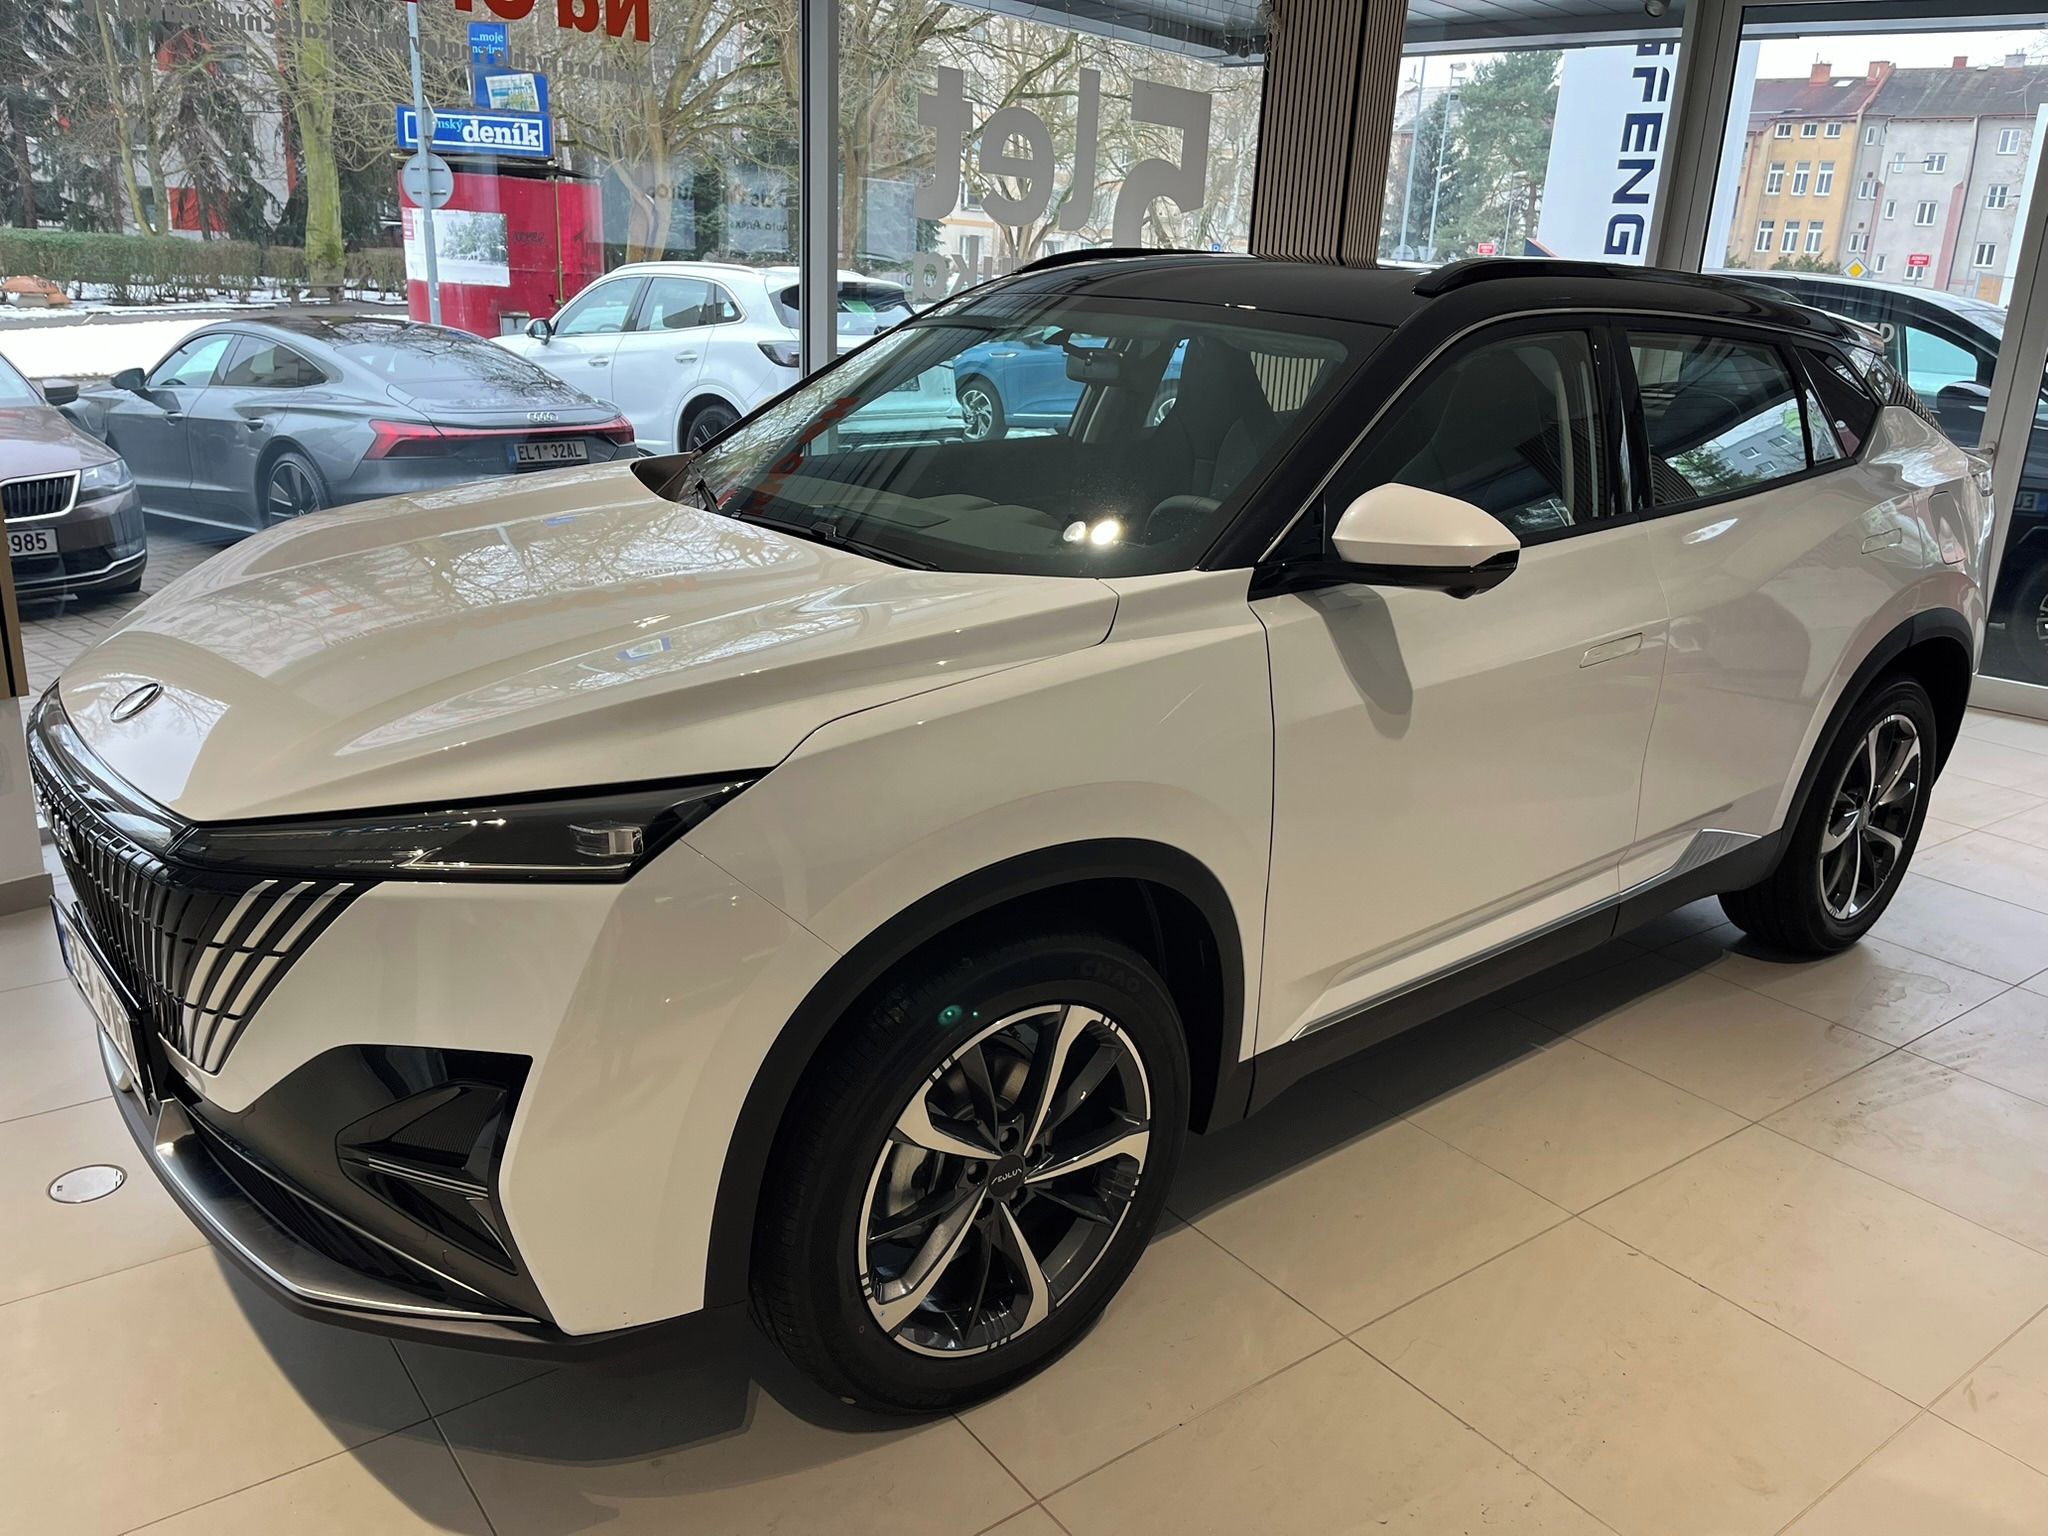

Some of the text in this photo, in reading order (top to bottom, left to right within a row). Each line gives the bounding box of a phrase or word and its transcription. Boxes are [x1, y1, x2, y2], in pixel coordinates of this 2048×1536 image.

[437, 118, 540, 147] nský deník
[517, 445, 542, 461] EL1
[550, 441, 582, 459] 32AL
[10, 532, 47, 553] 985
